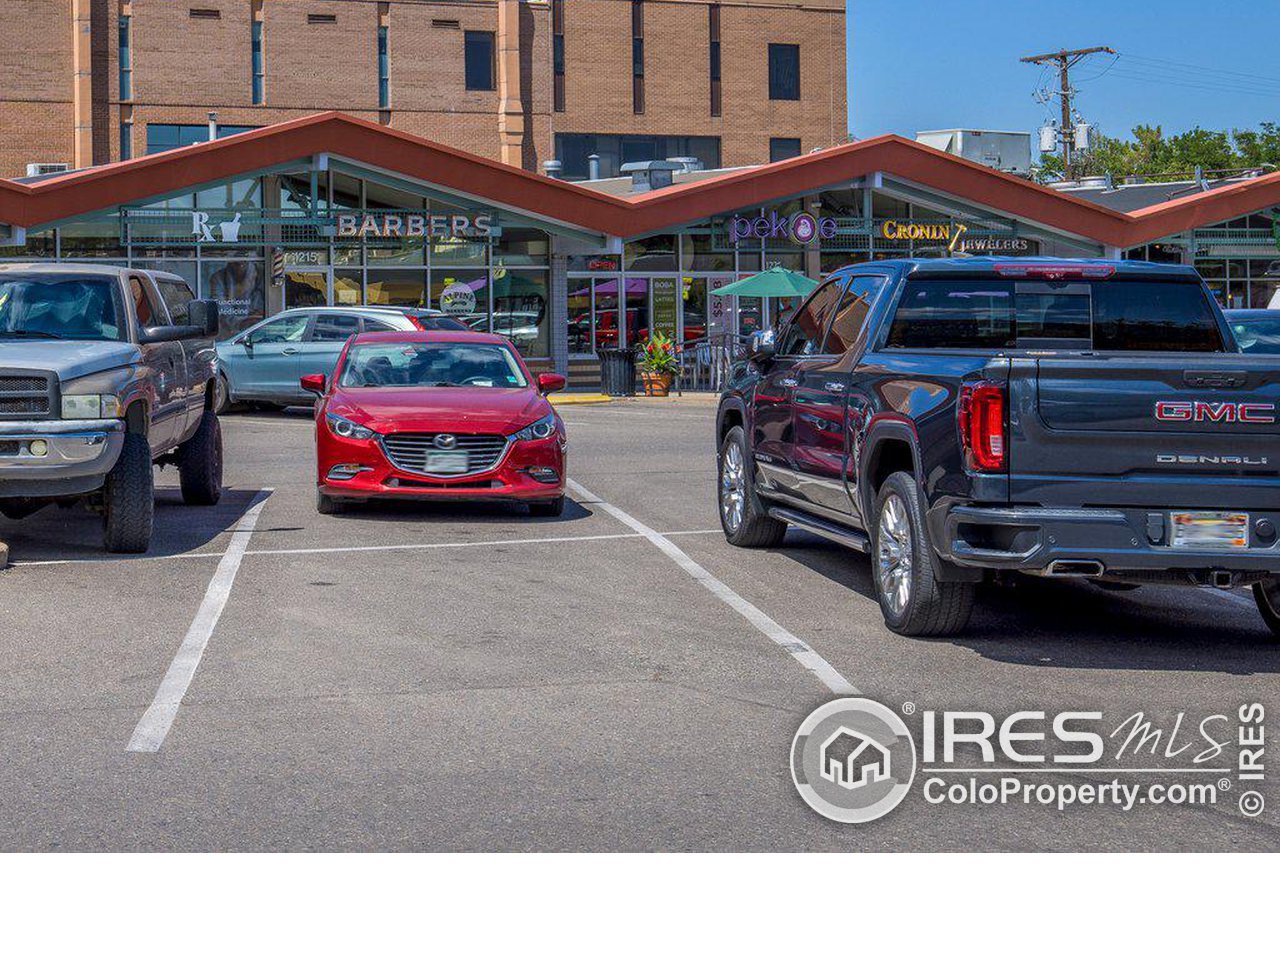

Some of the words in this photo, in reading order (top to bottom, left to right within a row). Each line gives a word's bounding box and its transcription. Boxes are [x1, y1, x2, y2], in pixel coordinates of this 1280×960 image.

[338, 214, 491, 237] BARBERS
[293, 251, 318, 262] 1215
[1155, 401, 1275, 423] GMC
[1156, 454, 1267, 465] DENALI
